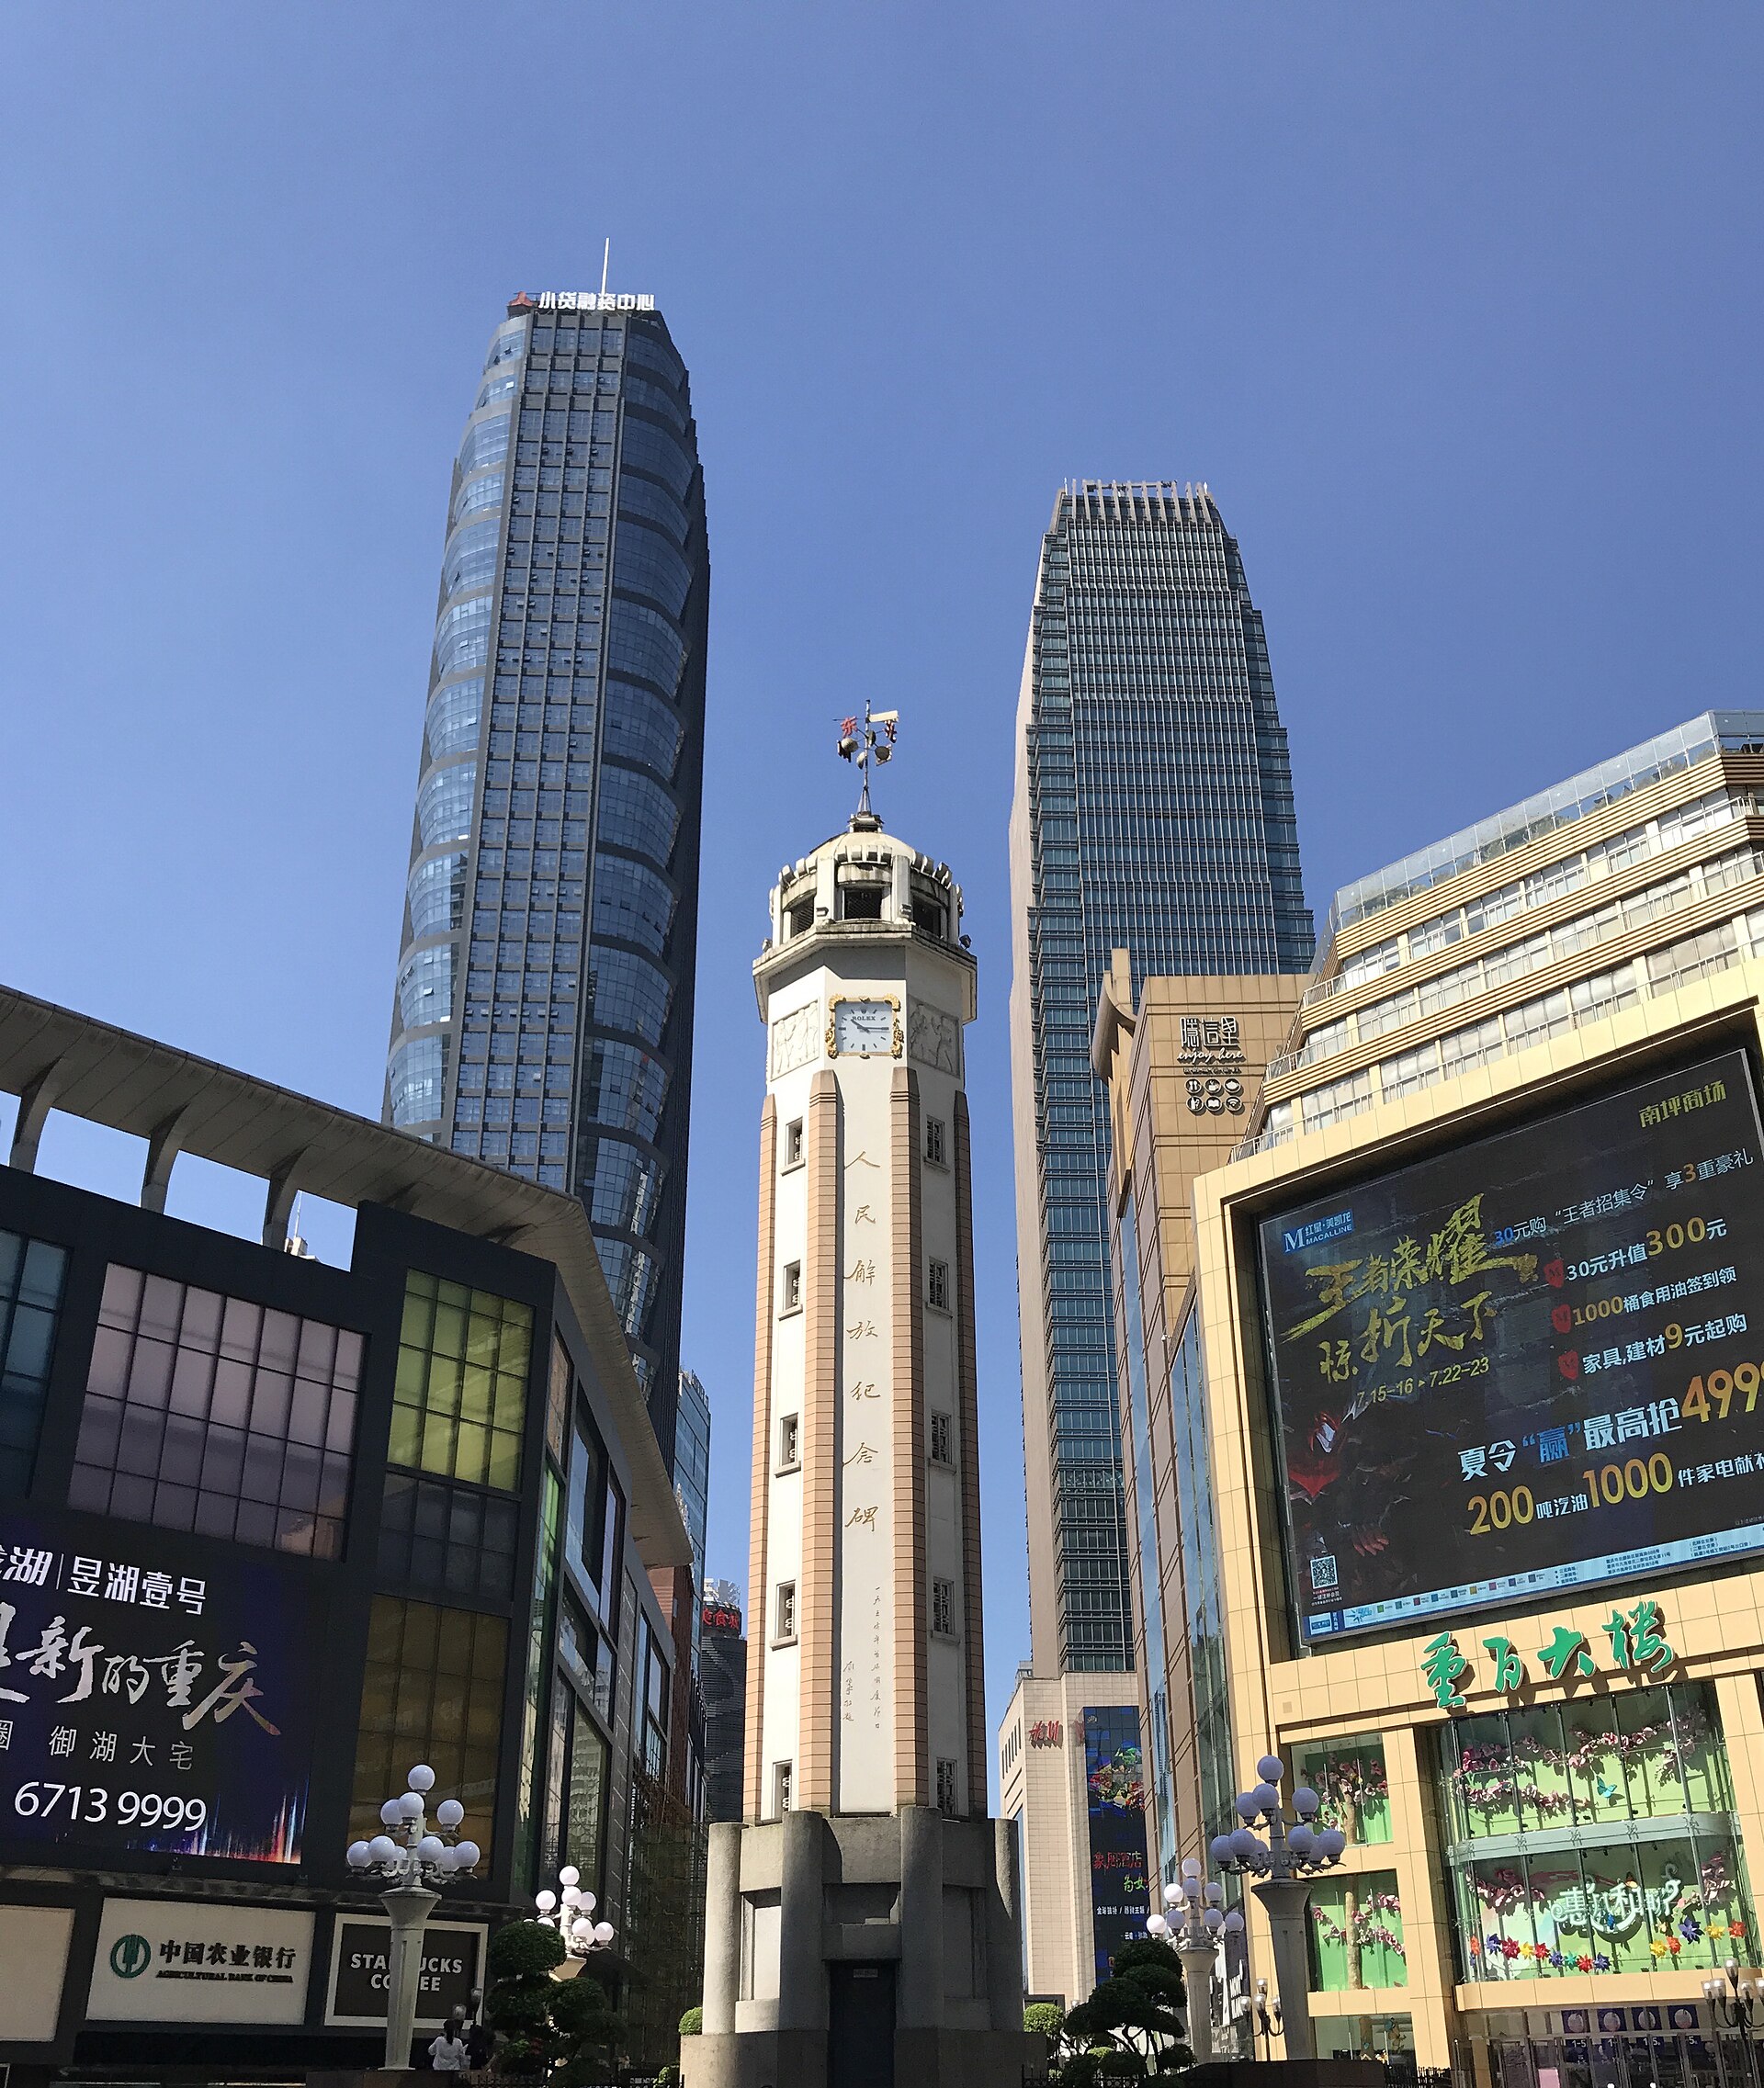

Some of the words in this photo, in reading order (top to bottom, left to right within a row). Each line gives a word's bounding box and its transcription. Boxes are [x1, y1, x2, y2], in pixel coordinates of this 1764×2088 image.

[538, 291, 655, 310] 小贷融资中心
[1178, 1048, 1214, 1063] enjoy
[1218, 1047, 1243, 1060] here
[1638, 1079, 1727, 1128] 南坪商场
[1283, 1227, 1305, 1253] M
[1306, 1224, 1352, 1245] MACALLINE
[1566, 1216, 1727, 1281] 30元升值300元
[1280, 1192, 1539, 1344] 王者荣耀
[1572, 1266, 1737, 1326] 1000桶食用油签到领
[842, 1150, 880, 1533] 人民解放纪念碑
[1429, 1357, 1489, 1388] 7.22-23
[1458, 1360, 1764, 1481] 夏令“赢”最高抢499
[0, 1544, 53, 1586] 湖
[67, 1555, 207, 1616] 昱湖壹号
[49, 1725, 194, 1771] 御湖大宅
[15, 1781, 108, 1822] 6713
[117, 1791, 207, 1832] 9999
[160, 1940, 296, 1969] 中国农业银行
[351, 1953, 462, 1974] STAUCKS
[370, 1973, 441, 1992] COEE
